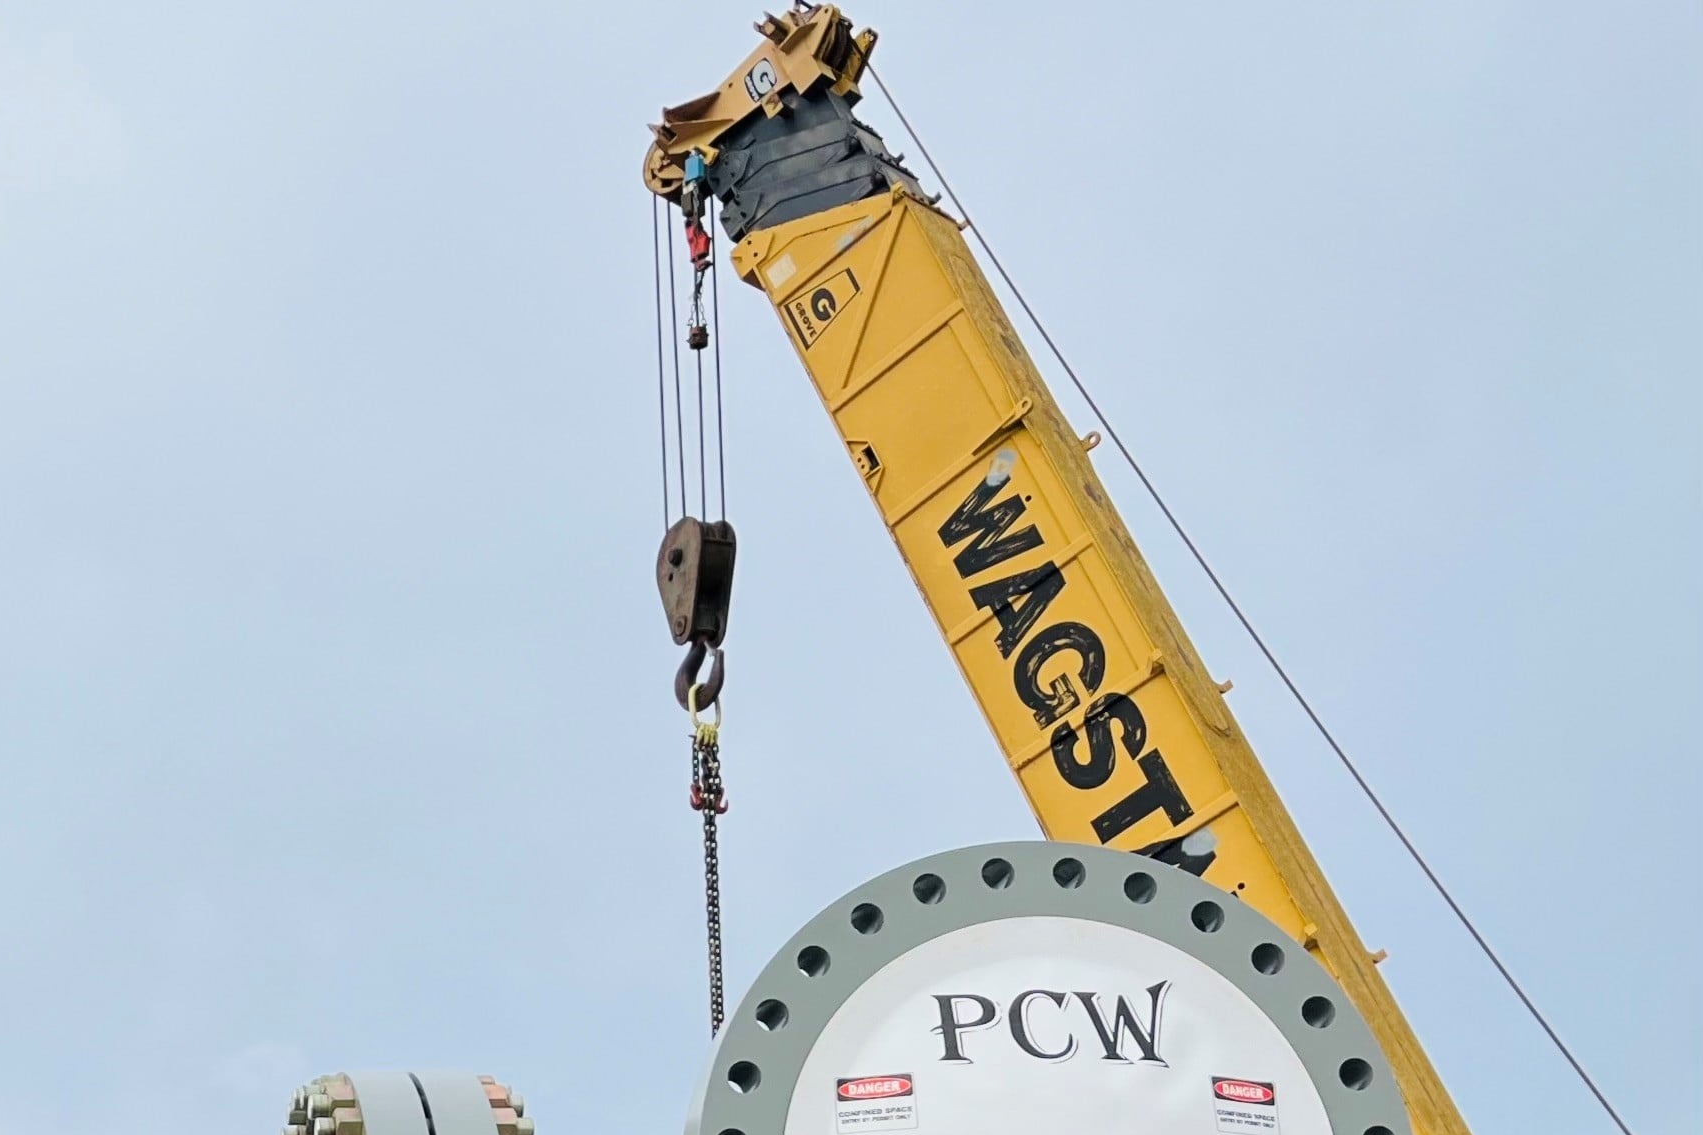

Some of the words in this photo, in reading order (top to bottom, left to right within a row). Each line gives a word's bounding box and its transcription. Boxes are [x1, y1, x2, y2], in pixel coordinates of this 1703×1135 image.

[811, 288, 836, 321] G
[795, 302, 817, 338] GROVE
[930, 979, 1172, 1069] PCW
[848, 1081, 900, 1095] DANGER
[1222, 1083, 1264, 1099] DANGER
[838, 1109, 882, 1117] CONFINED
